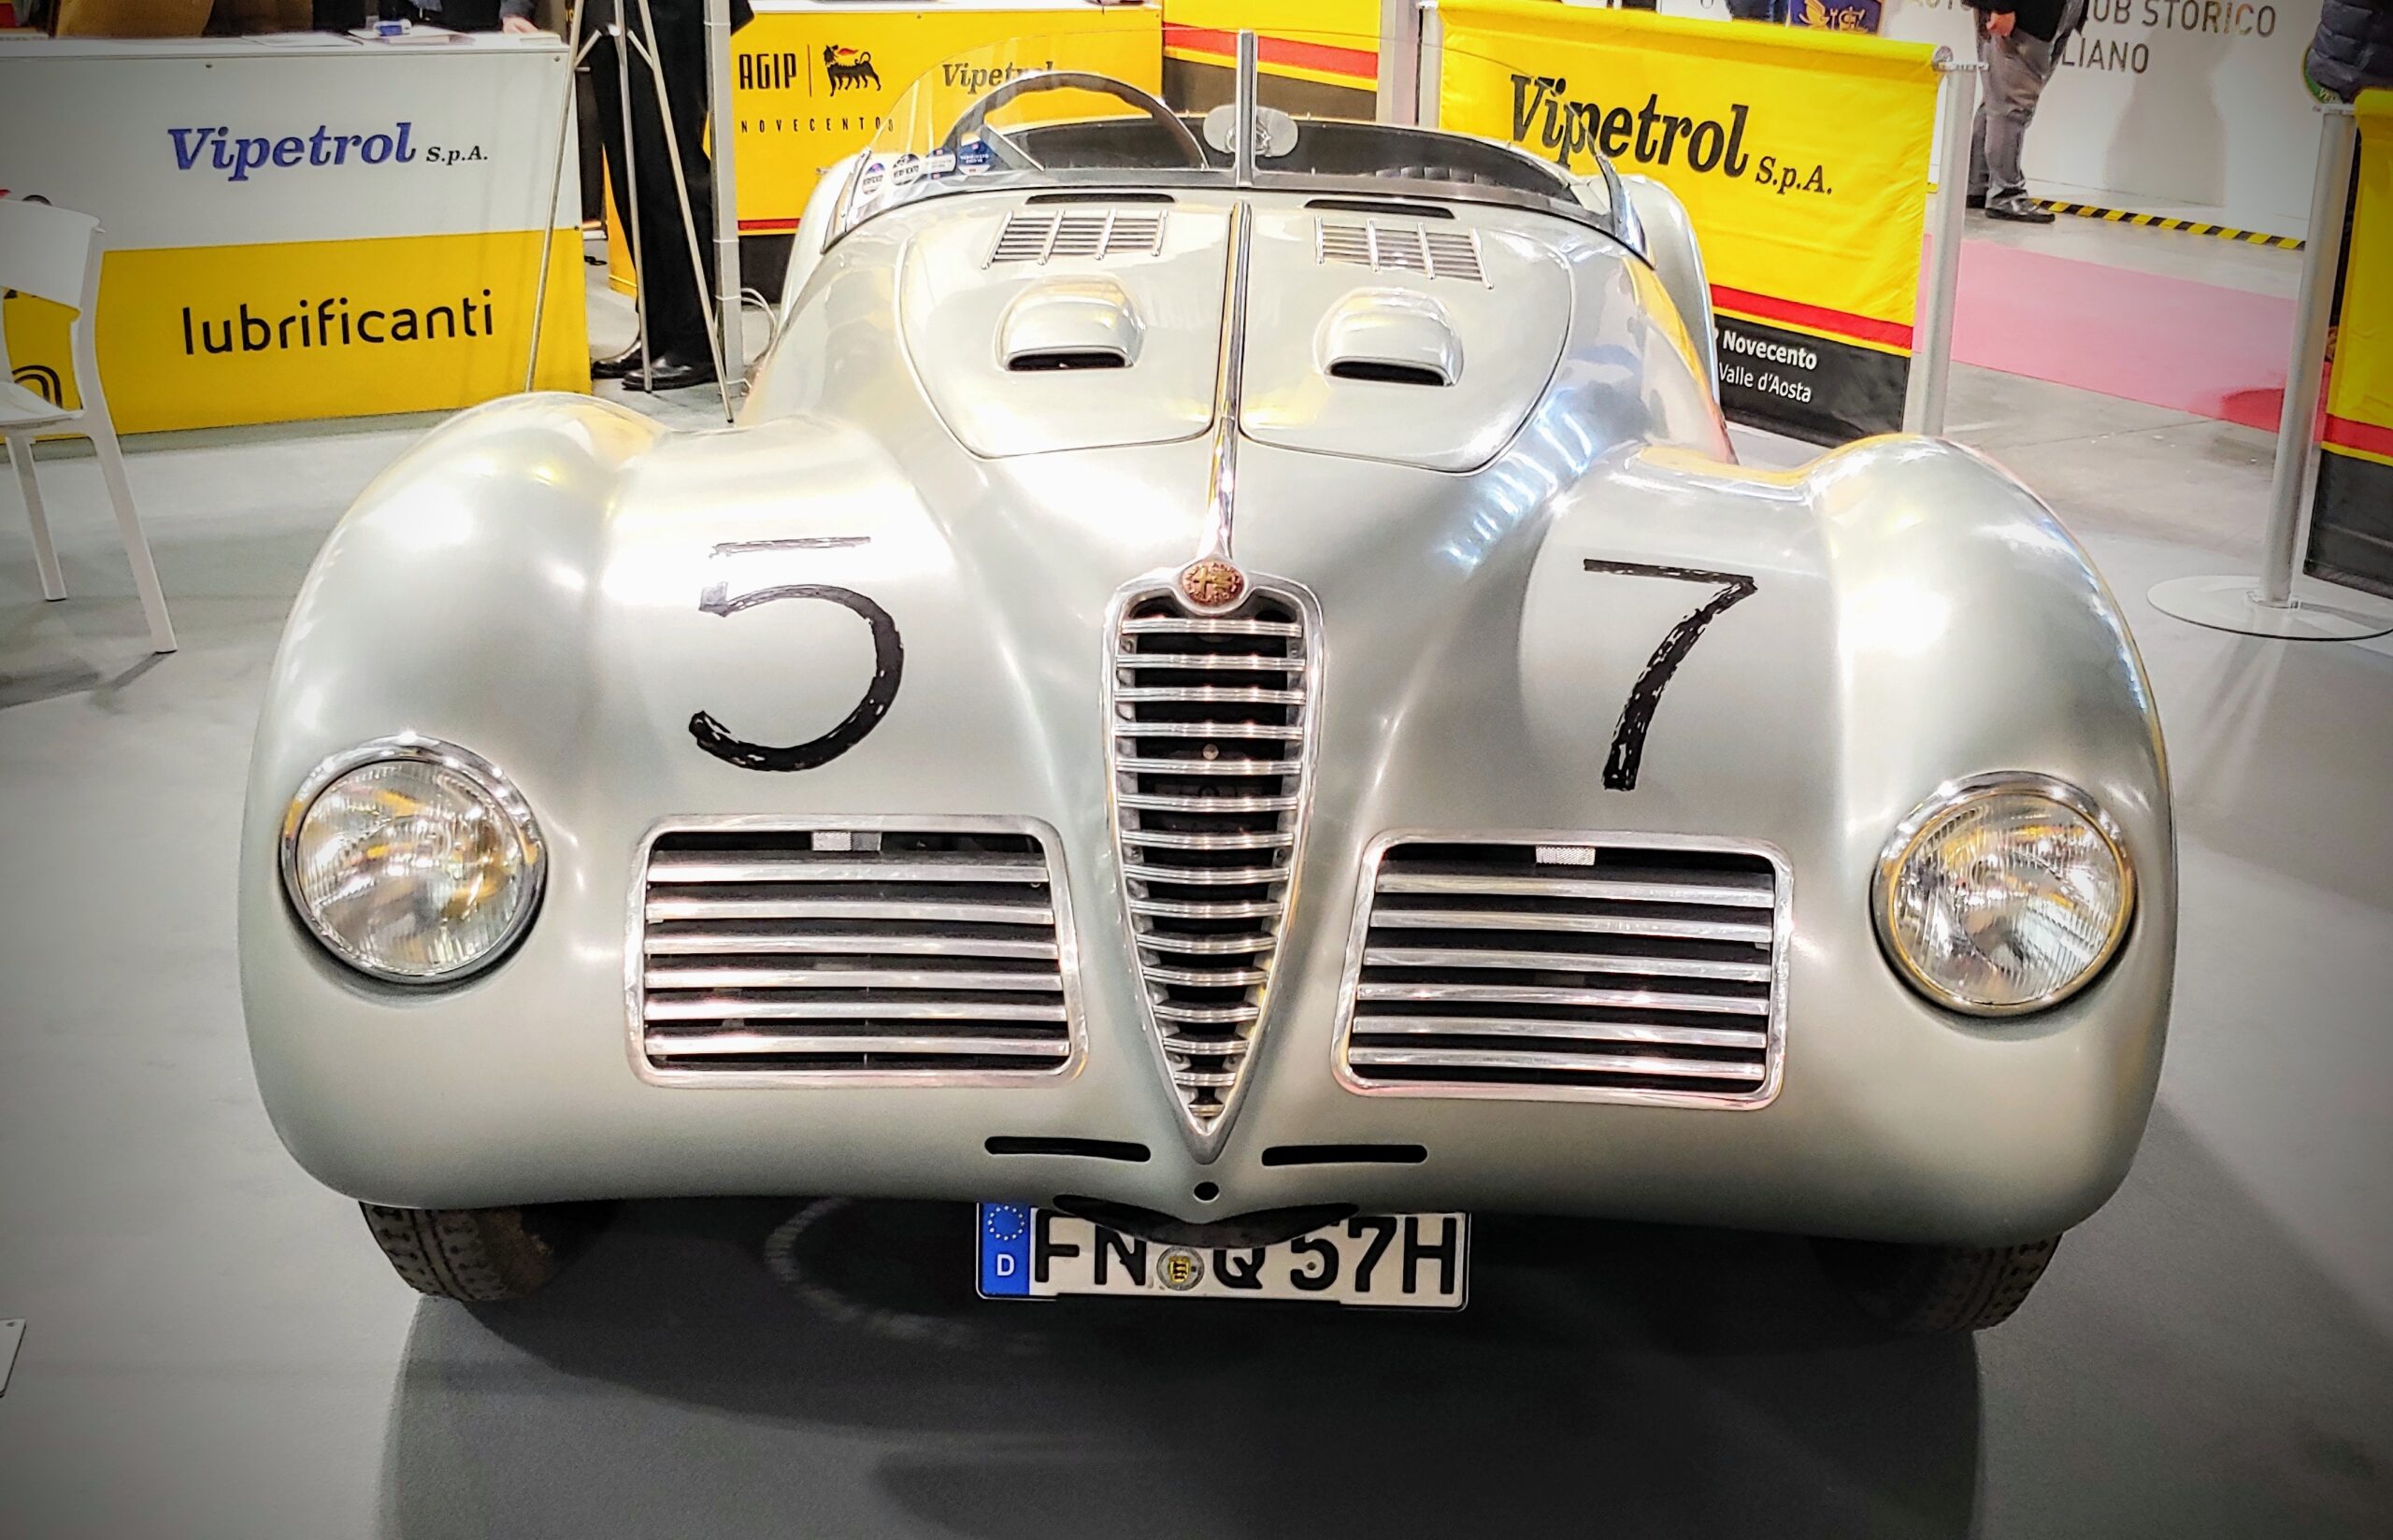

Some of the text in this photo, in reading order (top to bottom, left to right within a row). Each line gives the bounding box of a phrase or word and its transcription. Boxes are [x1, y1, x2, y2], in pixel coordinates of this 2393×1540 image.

[2093, 0, 2275, 37] UB STORICO
[738, 53, 796, 90] AGIP
[2061, 37, 2149, 74] LIANO
[741, 117, 881, 133] NOVECENTO
[1511, 74, 1832, 195] Vipetrol S.p.A.
[168, 122, 488, 181] Vipetrol S.p.A.
[182, 289, 493, 355] lubrificanti
[1723, 330, 1817, 370] Novecento
[1719, 362, 1812, 403] Valle d'Aosta
[689, 536, 1758, 791] 5 7
[996, 1254, 1015, 1276] D
[1035, 1208, 1147, 1286] FN
[1290, 1216, 1456, 1295] 57H
